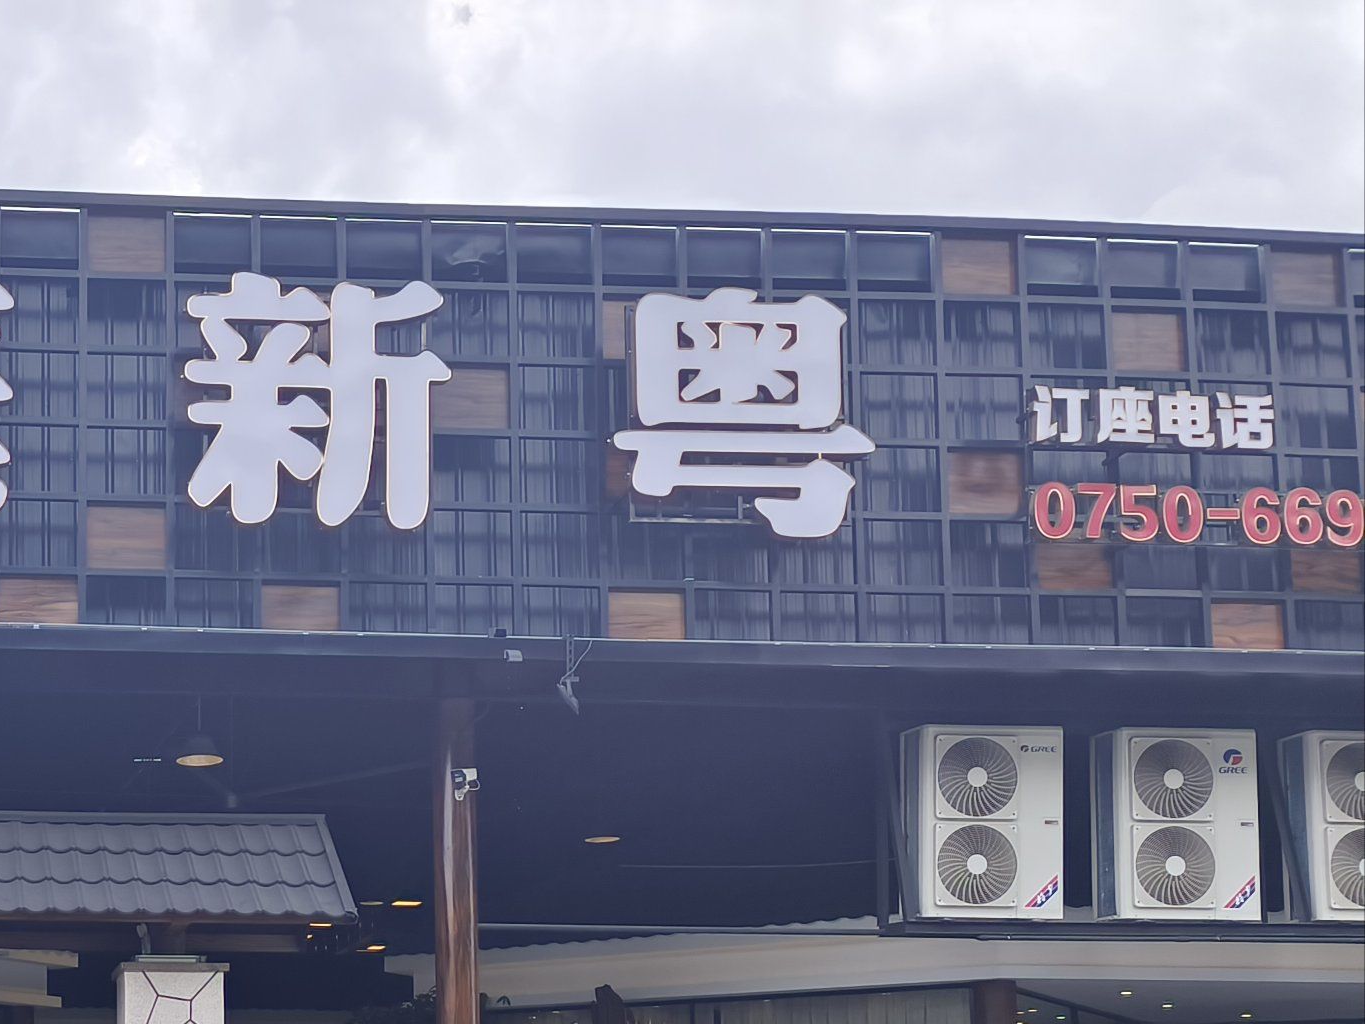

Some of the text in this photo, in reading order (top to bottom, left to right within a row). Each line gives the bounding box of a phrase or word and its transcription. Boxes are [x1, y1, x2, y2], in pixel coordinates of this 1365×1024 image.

[1033, 385, 1275, 449] 订座电话
[1033, 481, 1365, 546] 0750-669
[1219, 766, 1248, 774] GREE
